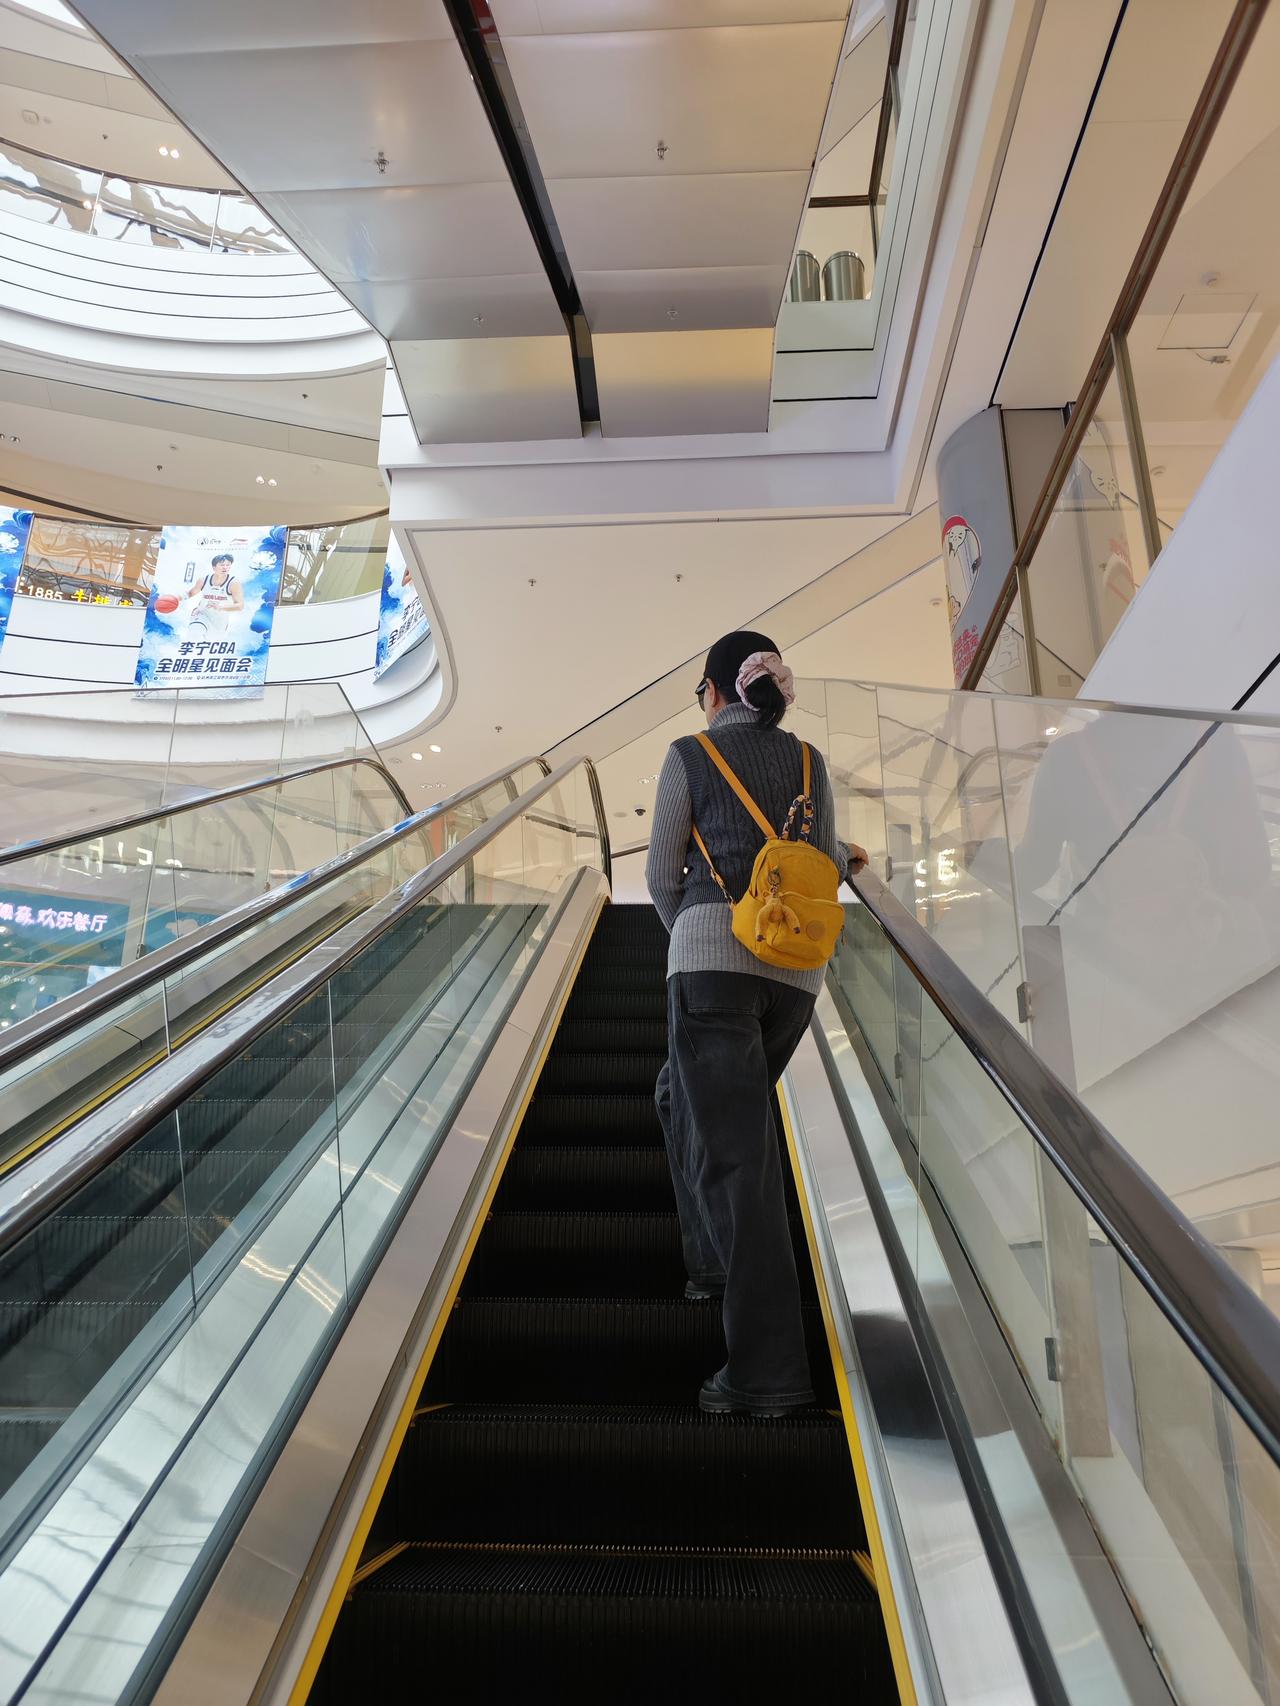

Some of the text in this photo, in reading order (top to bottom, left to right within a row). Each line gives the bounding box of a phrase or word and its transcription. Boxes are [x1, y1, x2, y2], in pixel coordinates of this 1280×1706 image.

[27, 585, 64, 601] 1885
[178, 641, 236, 656] 李宁CBA
[155, 657, 252, 673] 全明星见面会
